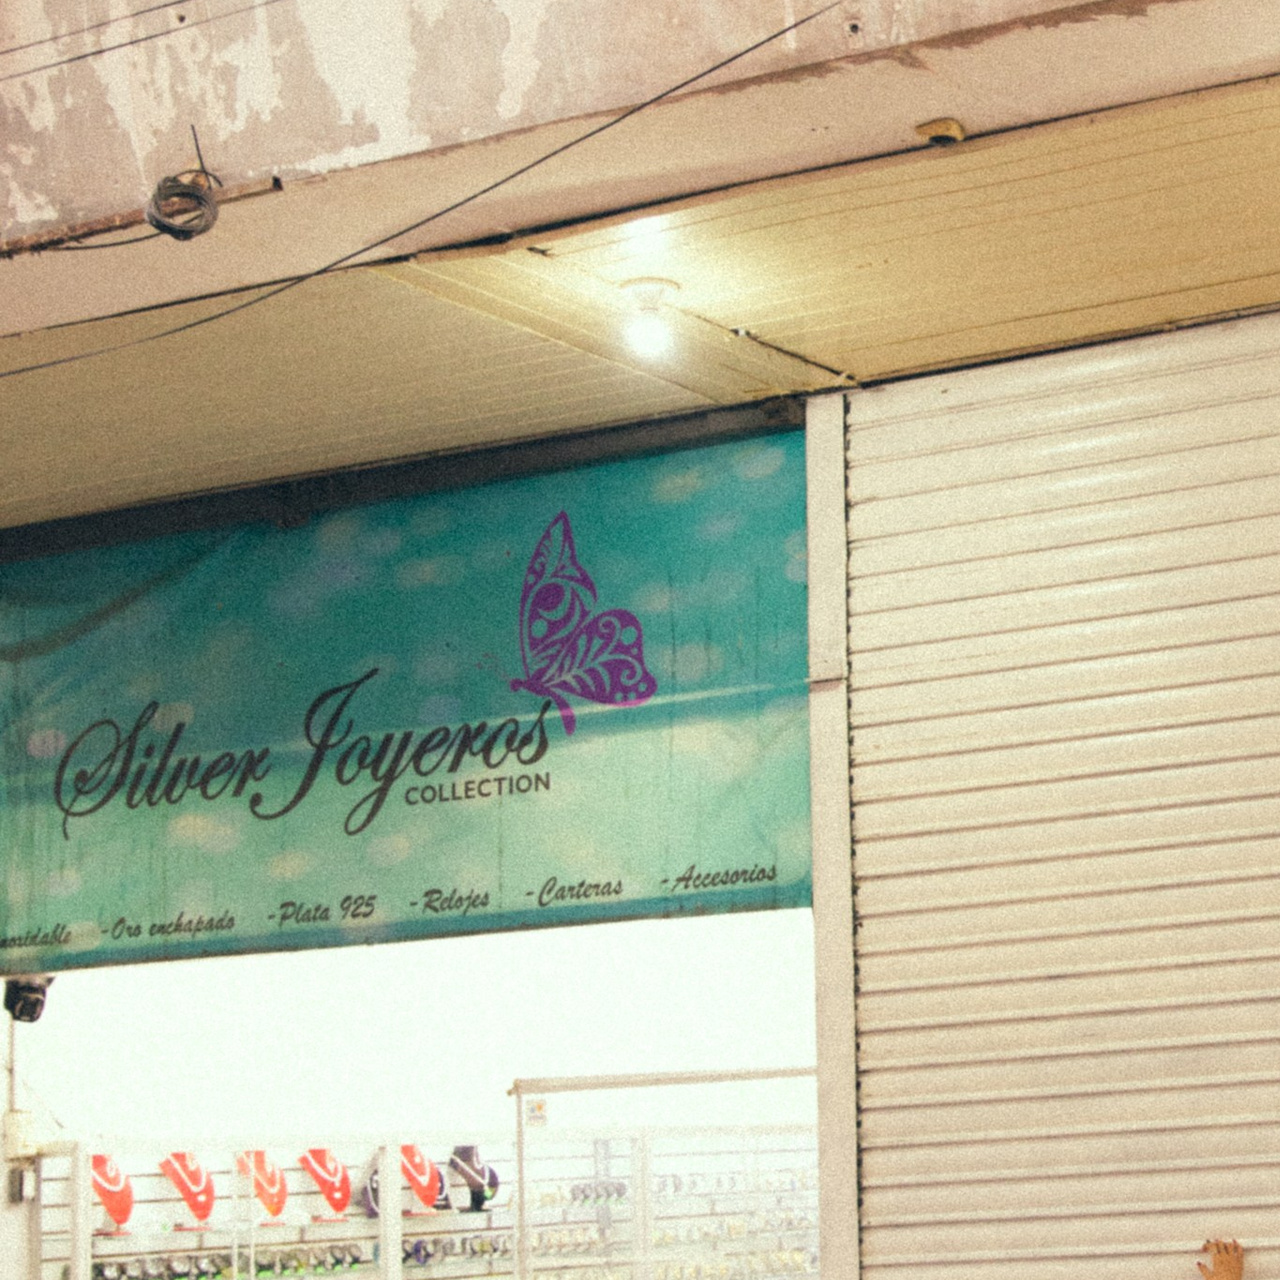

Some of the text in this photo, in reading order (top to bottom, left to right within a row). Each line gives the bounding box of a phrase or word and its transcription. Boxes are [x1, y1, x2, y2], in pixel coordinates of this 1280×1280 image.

[53, 667, 553, 840] Silver Joyeros
[405, 772, 551, 806] COLLECTION
[149, 910, 236, 938] enchapado
[339, 894, 377, 920] 925
